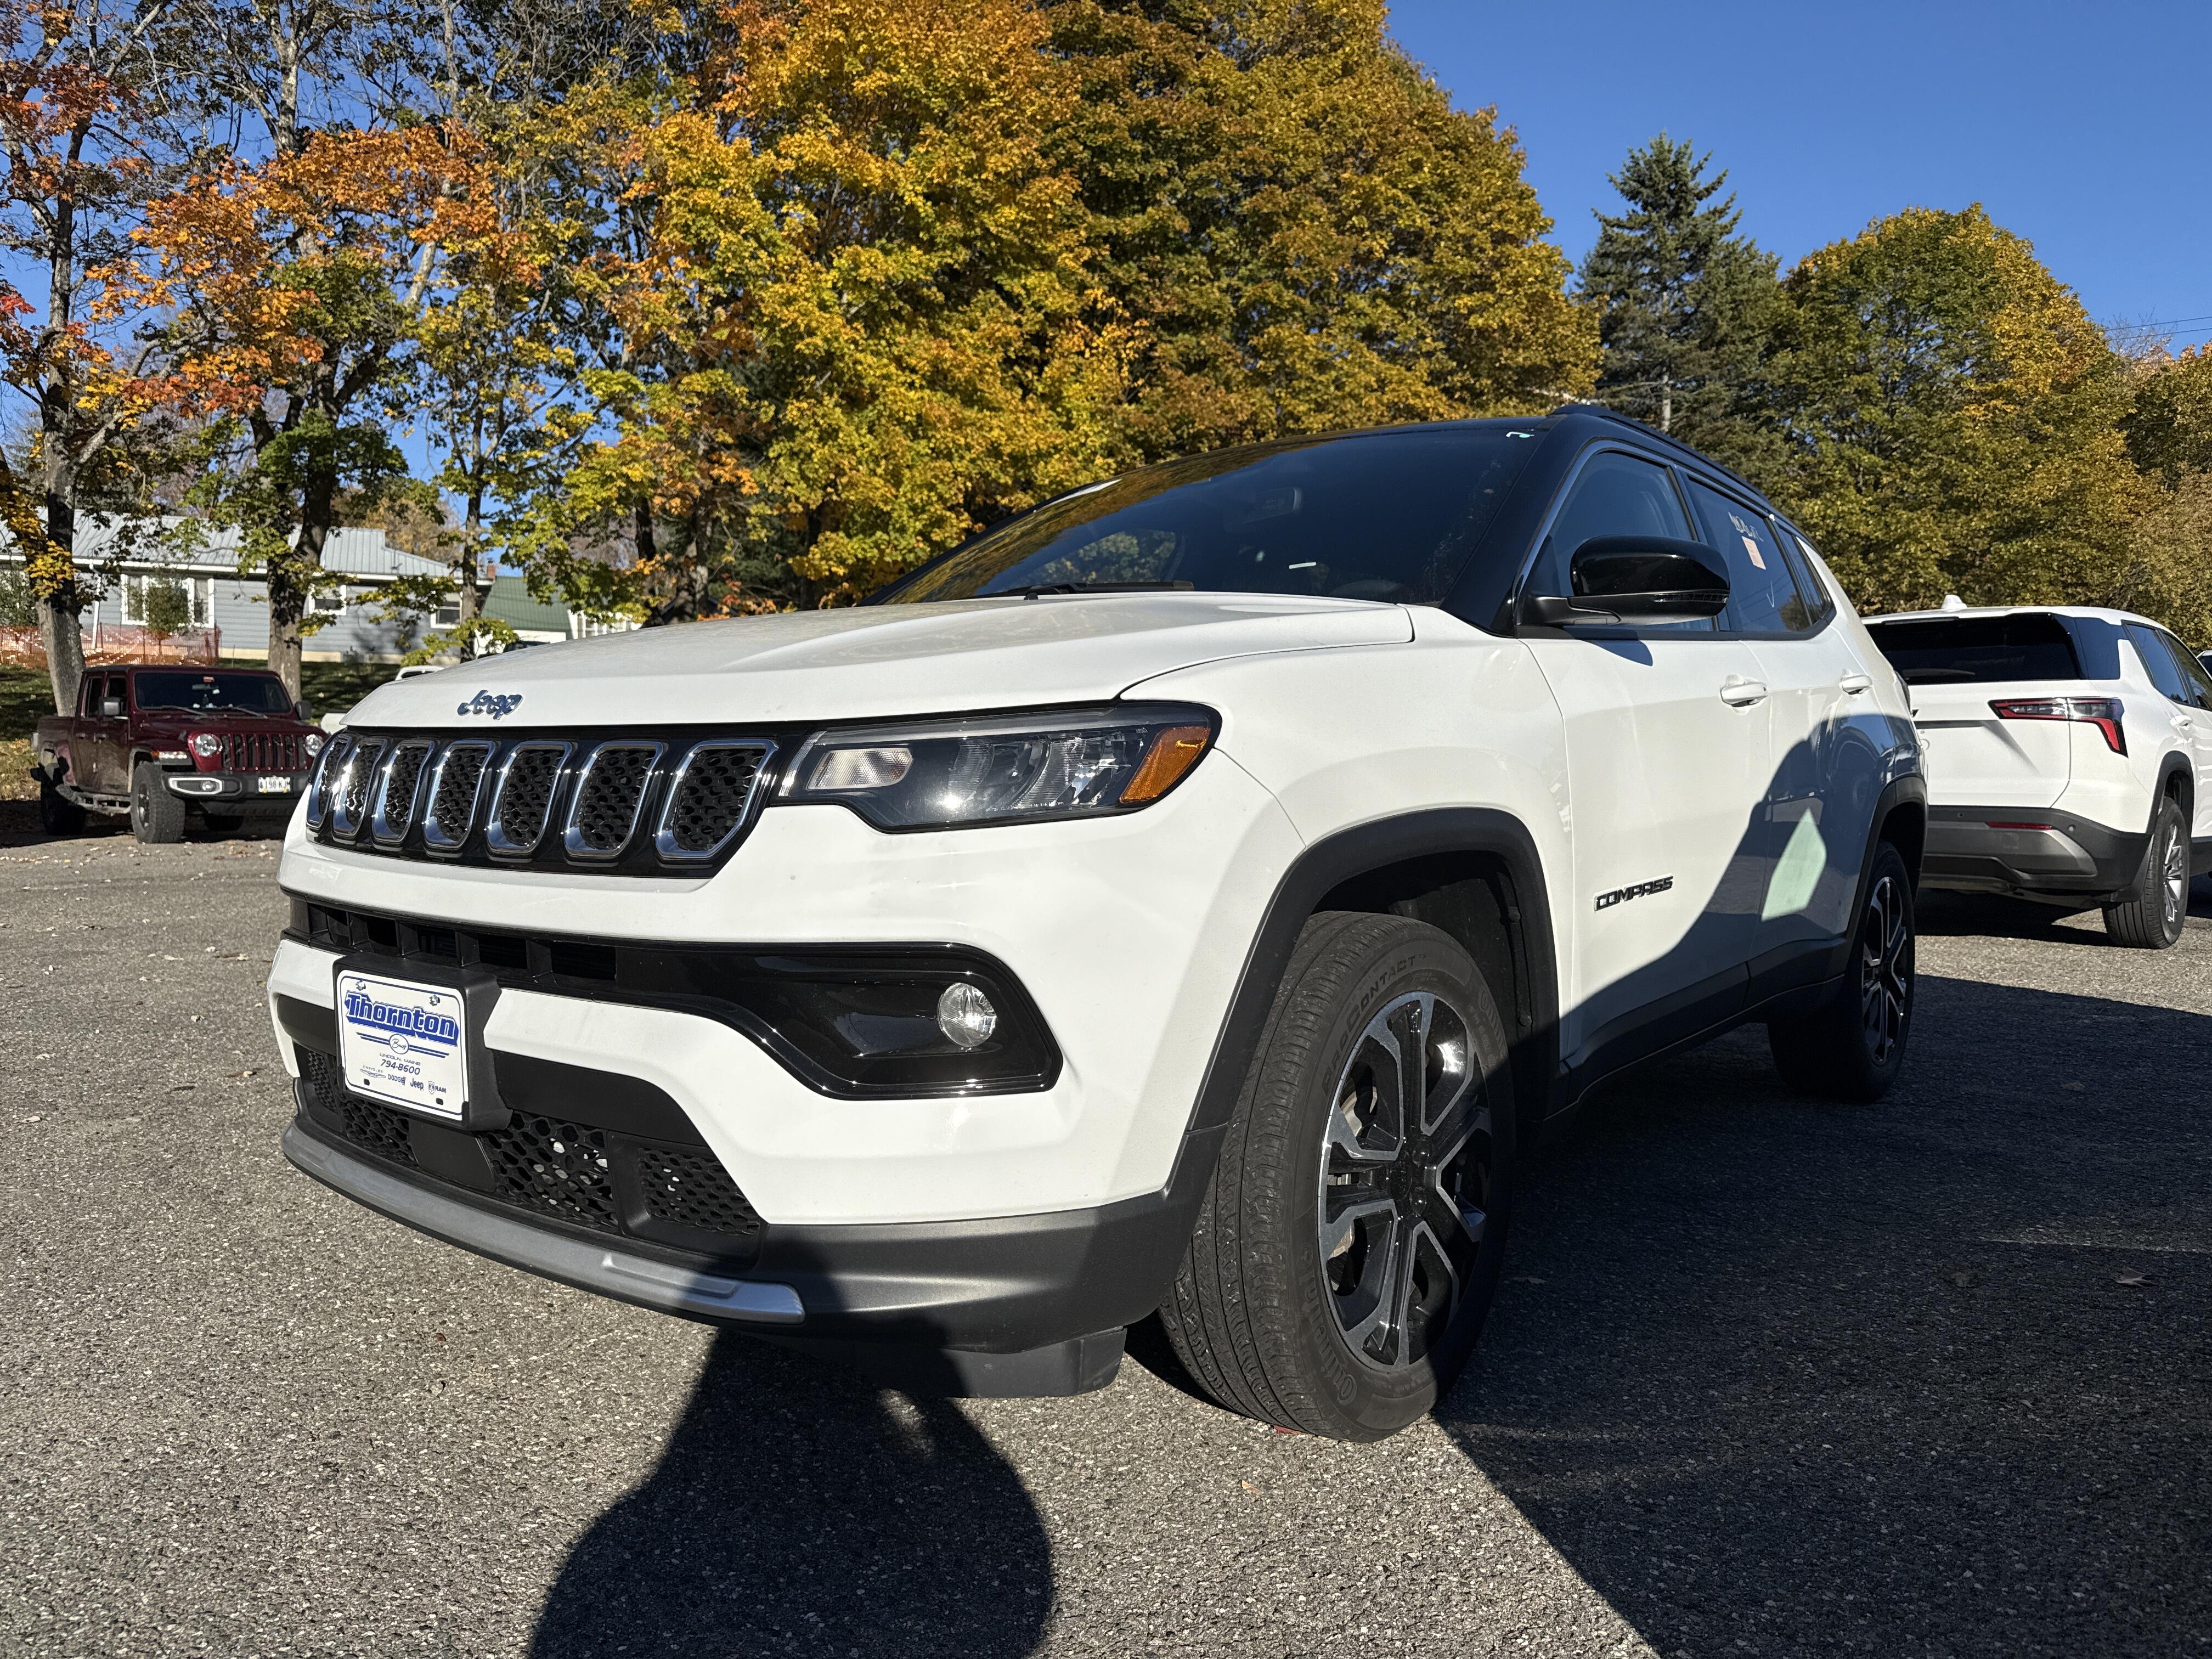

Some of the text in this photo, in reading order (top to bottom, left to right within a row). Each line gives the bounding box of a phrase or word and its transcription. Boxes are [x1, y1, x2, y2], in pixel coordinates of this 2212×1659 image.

[457, 690, 523, 720] Jeep
[1594, 875, 1673, 912] COMPASS
[345, 991, 458, 1043] Thornton
[388, 1074, 405, 1085] DODGE
[410, 1078, 424, 1091] Jeep
